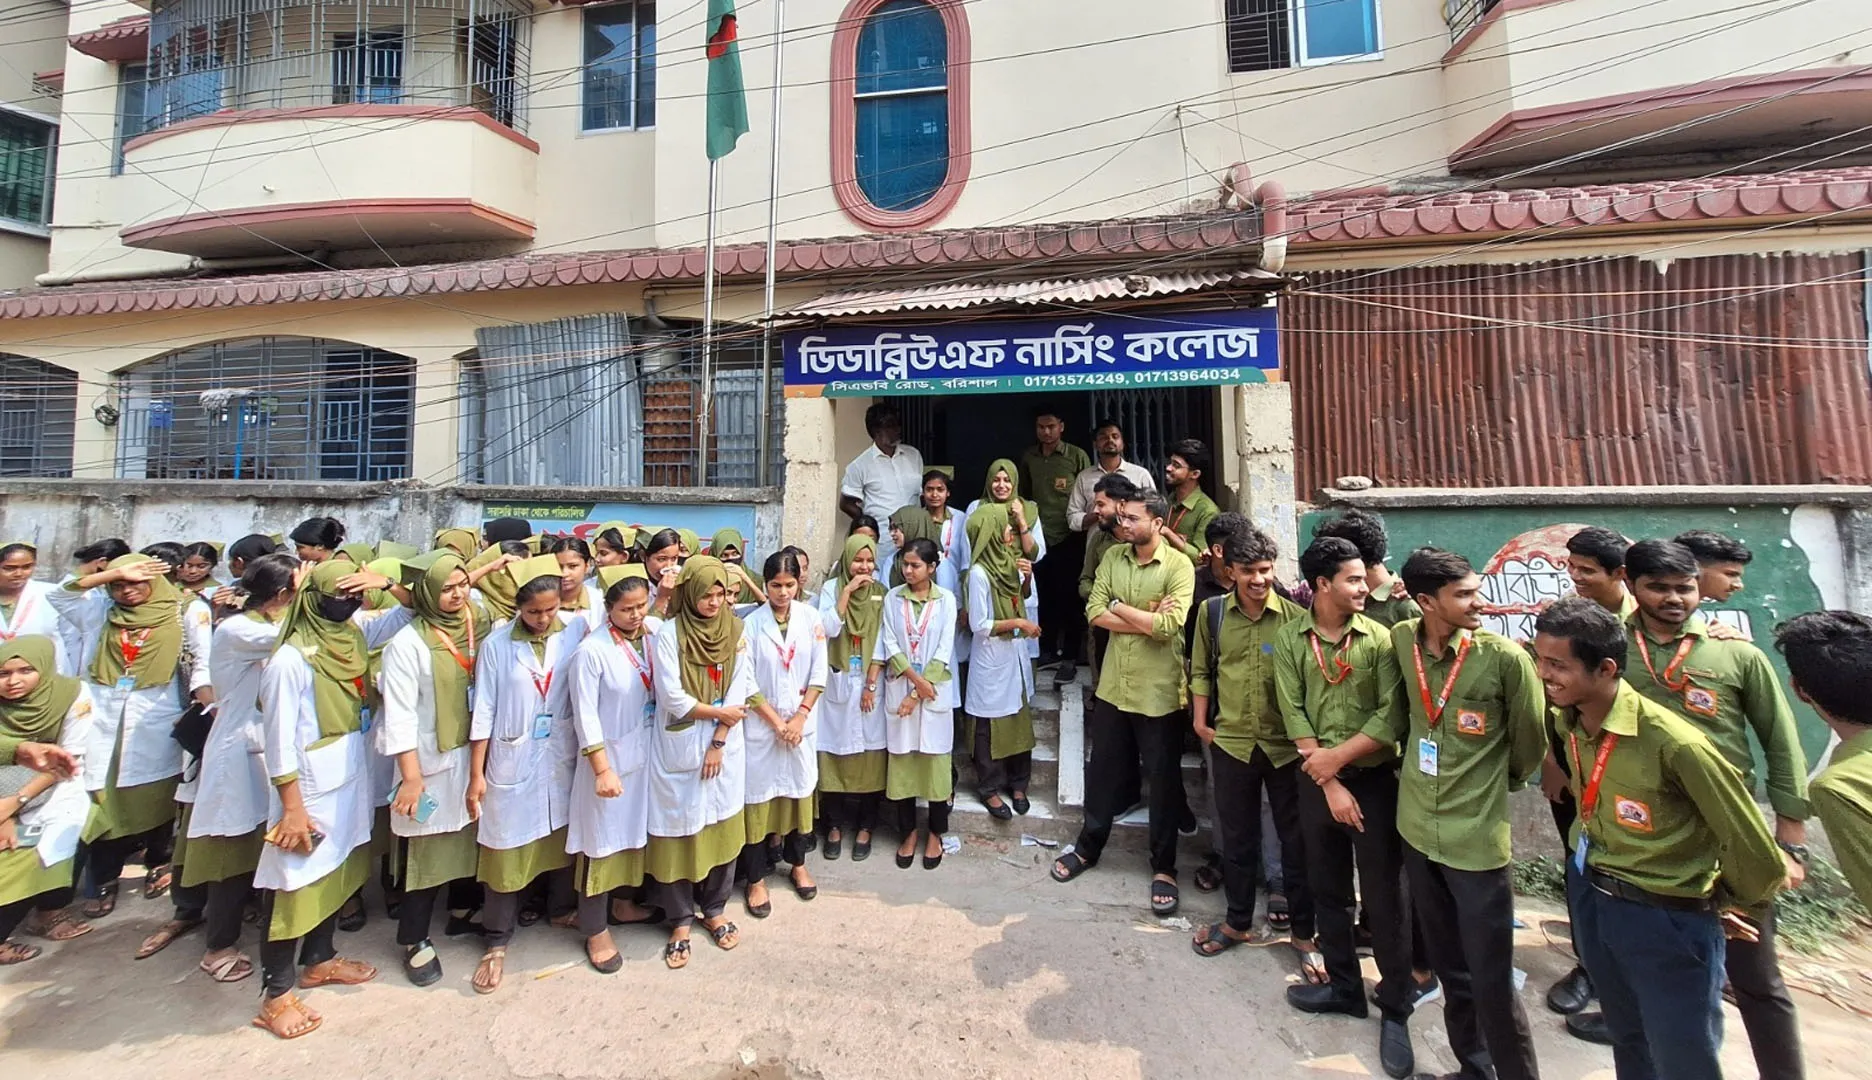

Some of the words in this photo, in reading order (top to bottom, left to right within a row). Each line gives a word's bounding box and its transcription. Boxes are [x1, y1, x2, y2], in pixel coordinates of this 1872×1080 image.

[798, 333, 1007, 380] ডিডাব্লিউএফ
[1013, 322, 1116, 367] নার্সিং
[1123, 328, 1260, 363] কলেজ
[941, 377, 998, 389] বরিশাল
[1135, 367, 1240, 384] 01713964034
[531, 507, 550, 517] থেকে
[551, 505, 585, 518] পরিচালিত
